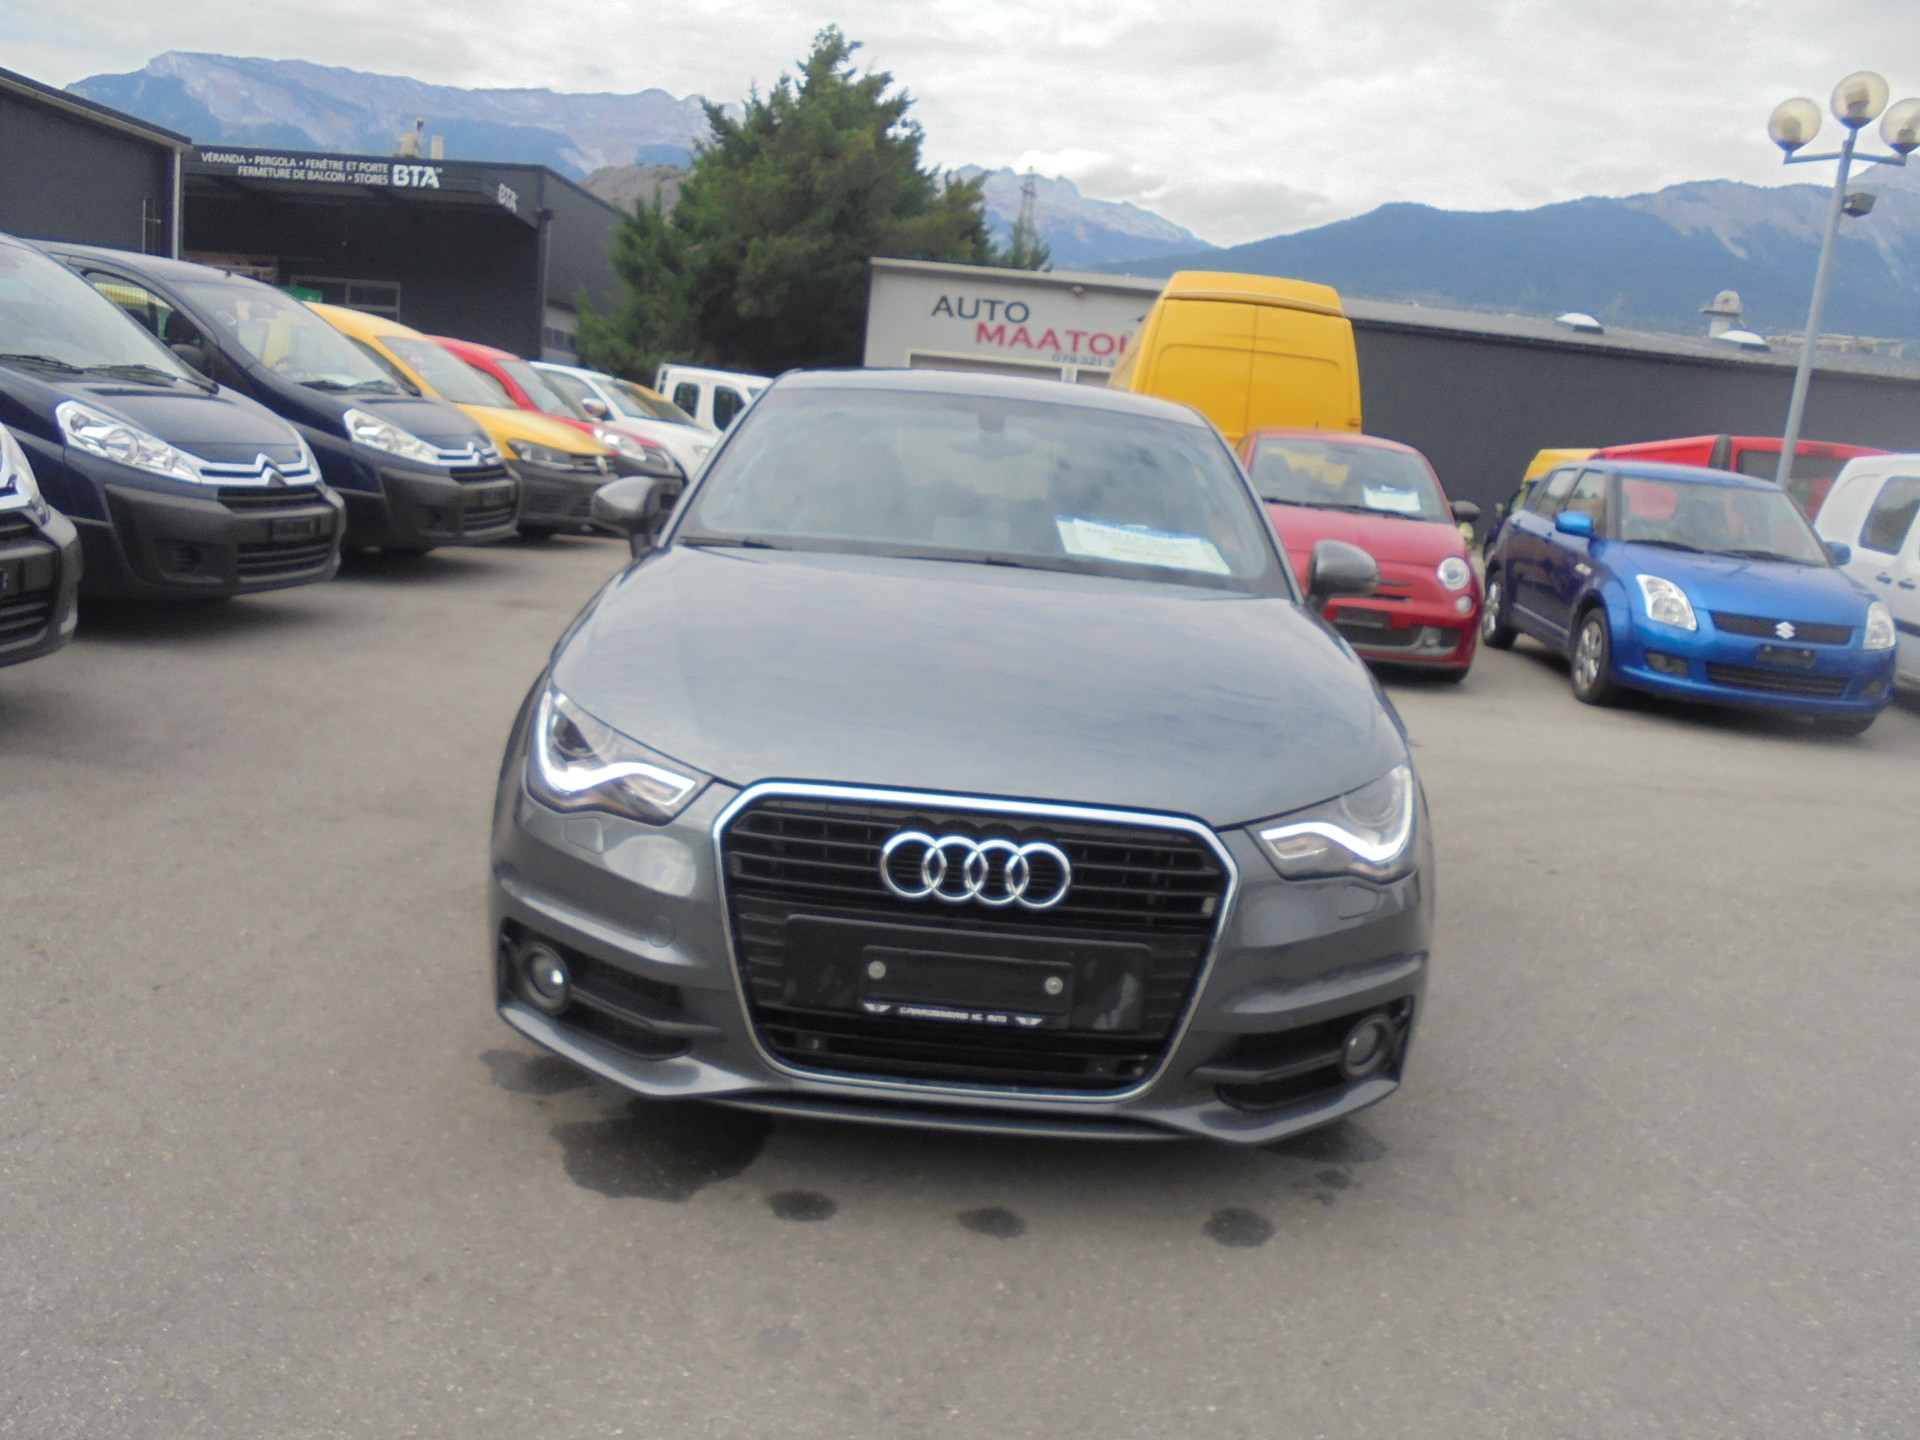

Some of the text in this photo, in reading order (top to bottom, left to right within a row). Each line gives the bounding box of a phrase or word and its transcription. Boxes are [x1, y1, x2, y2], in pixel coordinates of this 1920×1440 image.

[201, 151, 389, 174] VÉRANDA PERGOLA FENÊTRE ET PORTE
[237, 165, 389, 186] FERMETURE DE BALCON STORES
[393, 164, 439, 189] BTA
[498, 182, 517, 214] BTA
[931, 295, 1030, 324] AUTO
